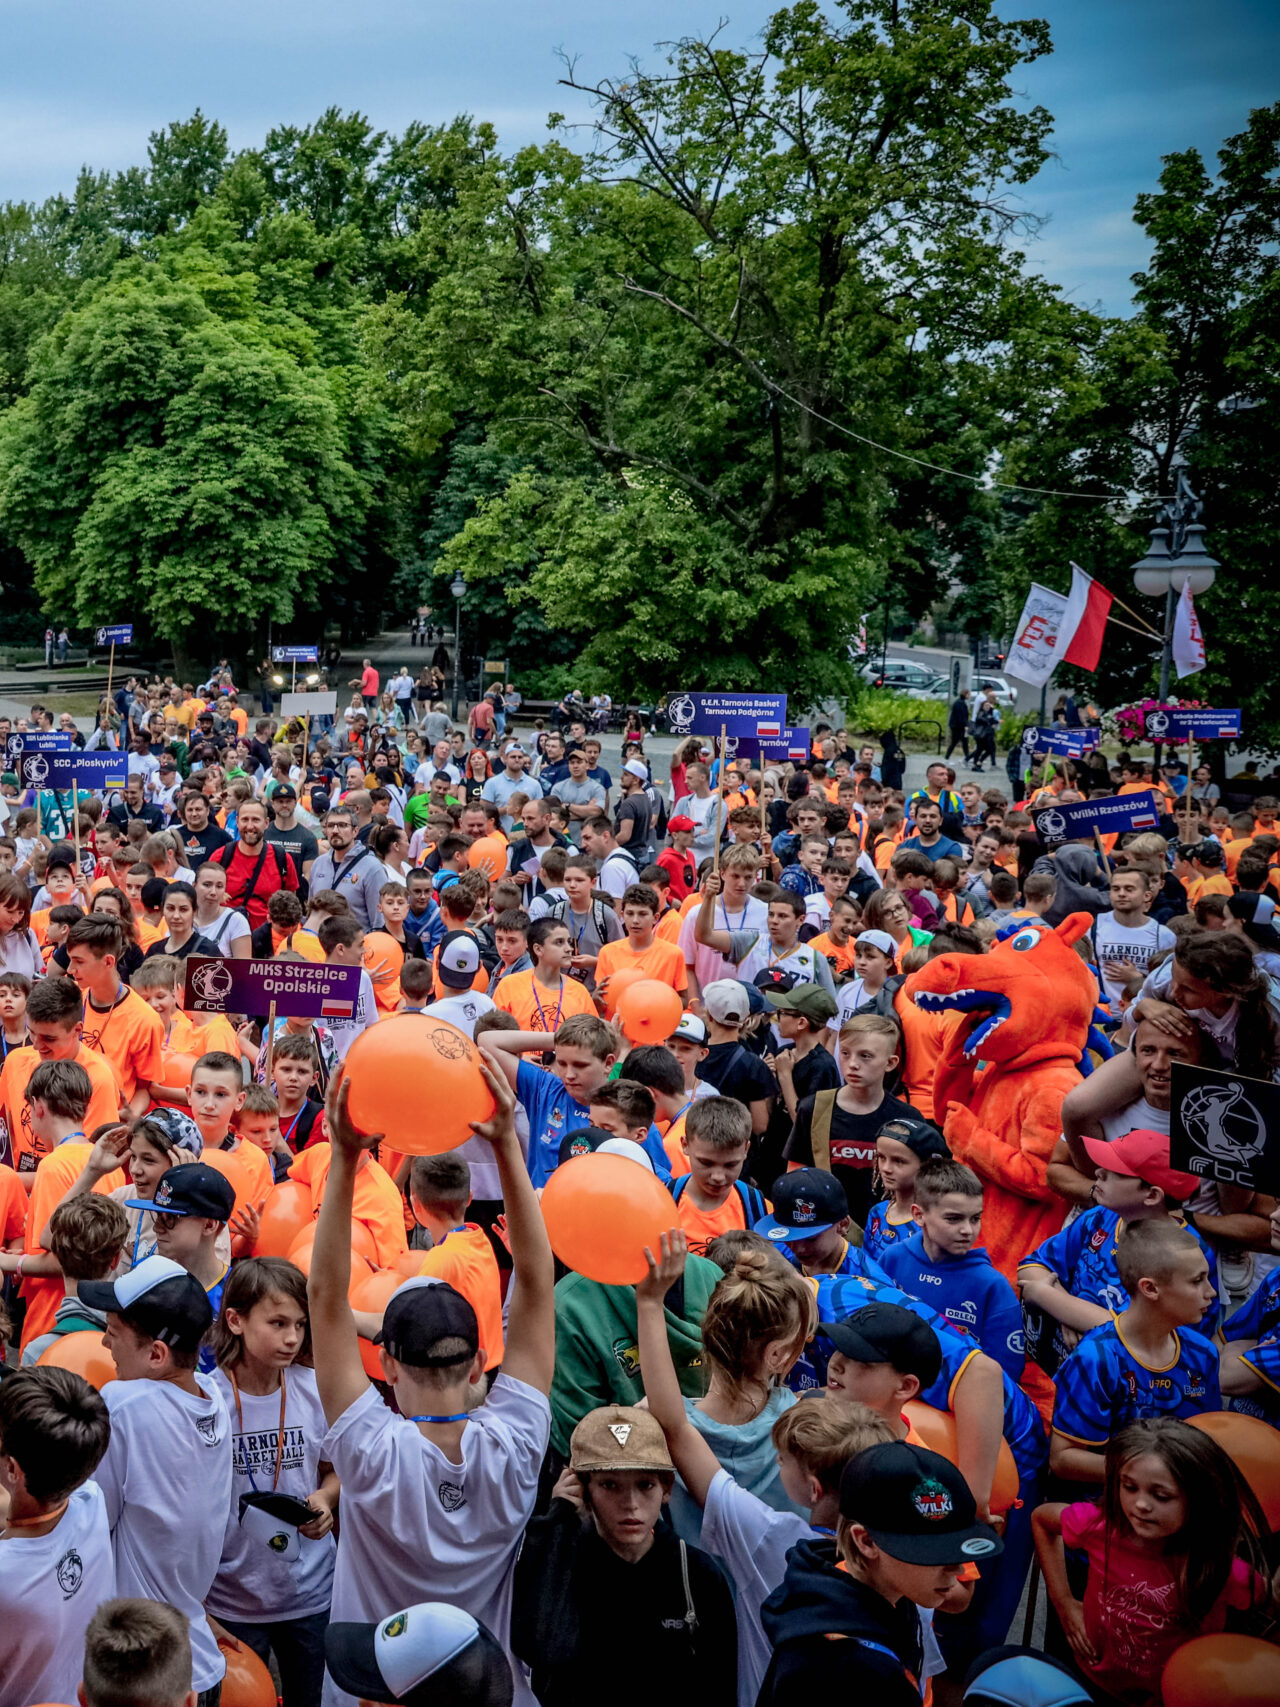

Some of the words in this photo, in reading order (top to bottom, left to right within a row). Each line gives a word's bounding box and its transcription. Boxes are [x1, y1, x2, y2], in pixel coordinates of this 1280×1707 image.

[721, 699, 752, 707] Tarnovia
[754, 700, 780, 708] Basket
[738, 708, 775, 717] Podgórne
[758, 738, 790, 747] Tarnów
[53, 759, 71, 768] SCC
[1069, 807, 1099, 820] Wilki
[1099, 801, 1149, 816] Rzeszów
[249, 963, 283, 977] MKS
[285, 965, 348, 981] Strzelce
[263, 979, 331, 994] Opolskie
[947, 1310, 976, 1323] ORLEN
[915, 1500, 953, 1513] WILKI
